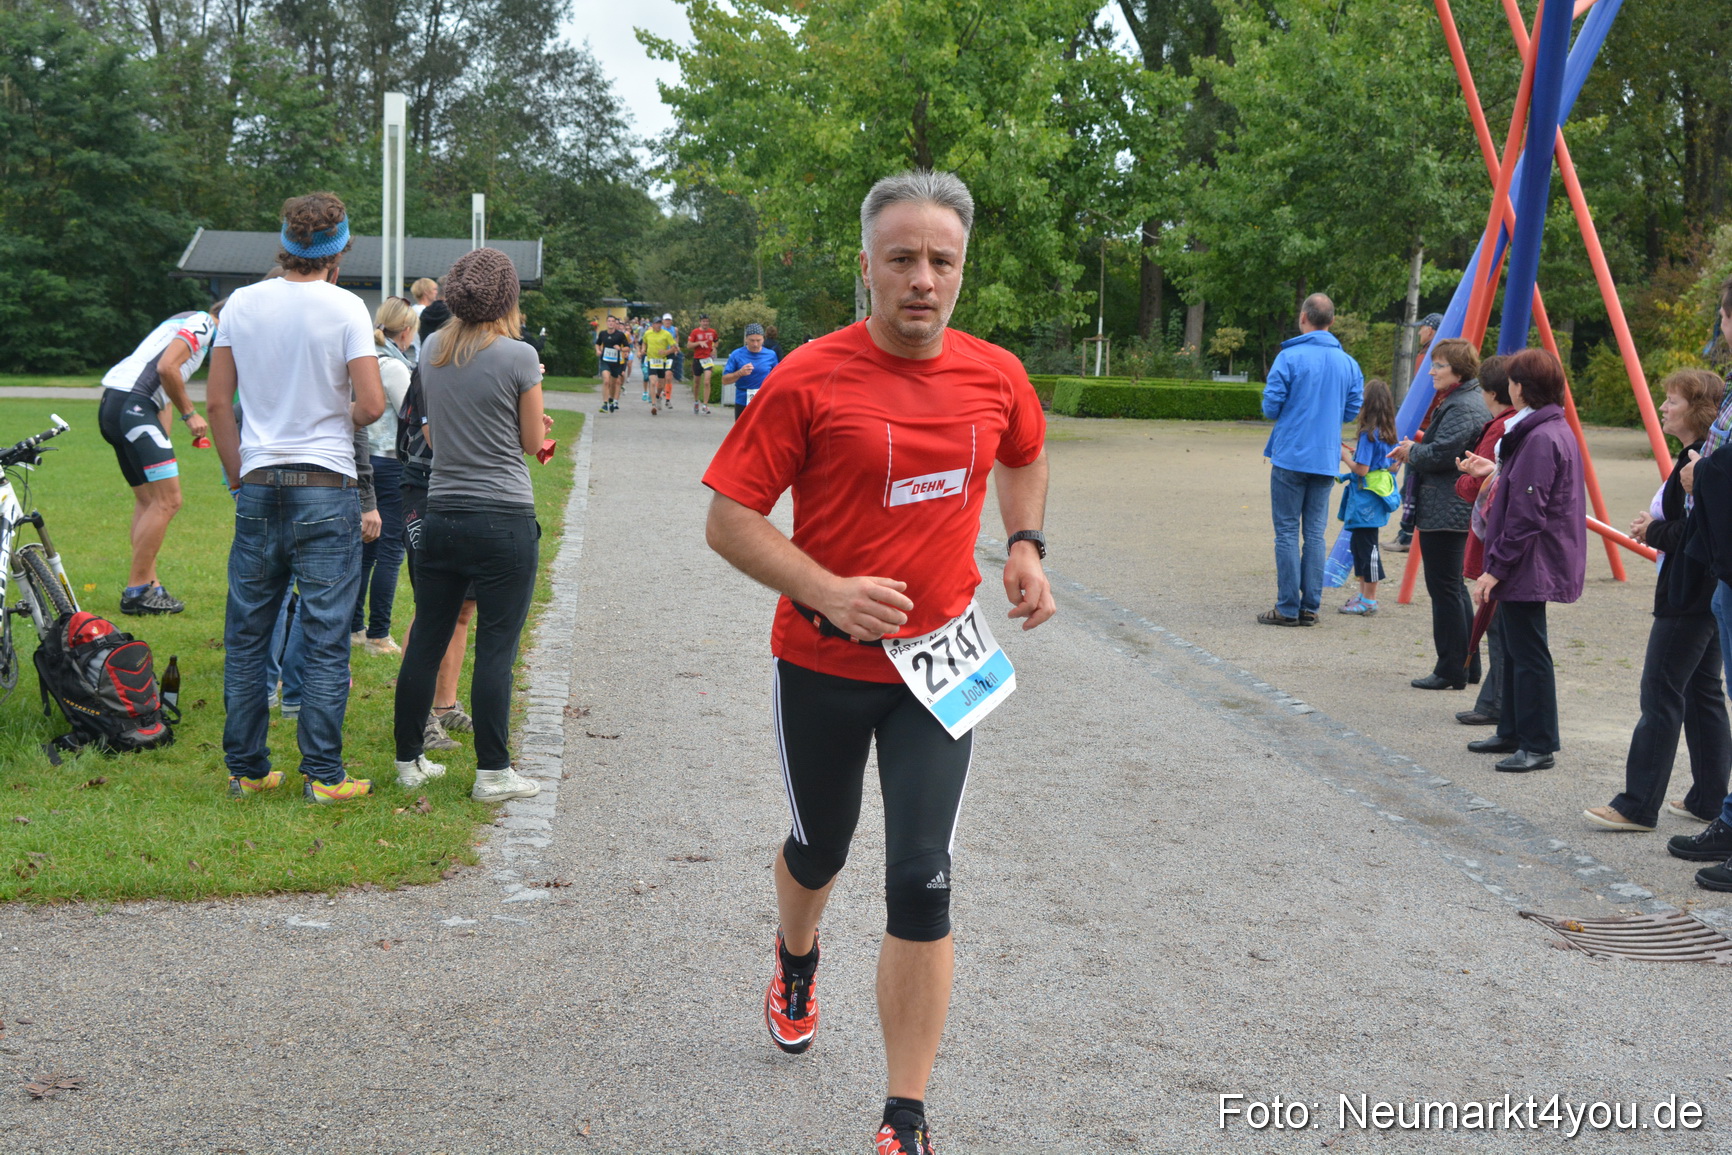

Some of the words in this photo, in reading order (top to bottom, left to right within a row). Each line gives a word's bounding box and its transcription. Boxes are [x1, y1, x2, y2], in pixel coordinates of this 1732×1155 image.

[911, 479, 946, 495] DEHN
[911, 610, 988, 695] 2747
[926, 696, 934, 705] A
[961, 671, 999, 707] Jochen
